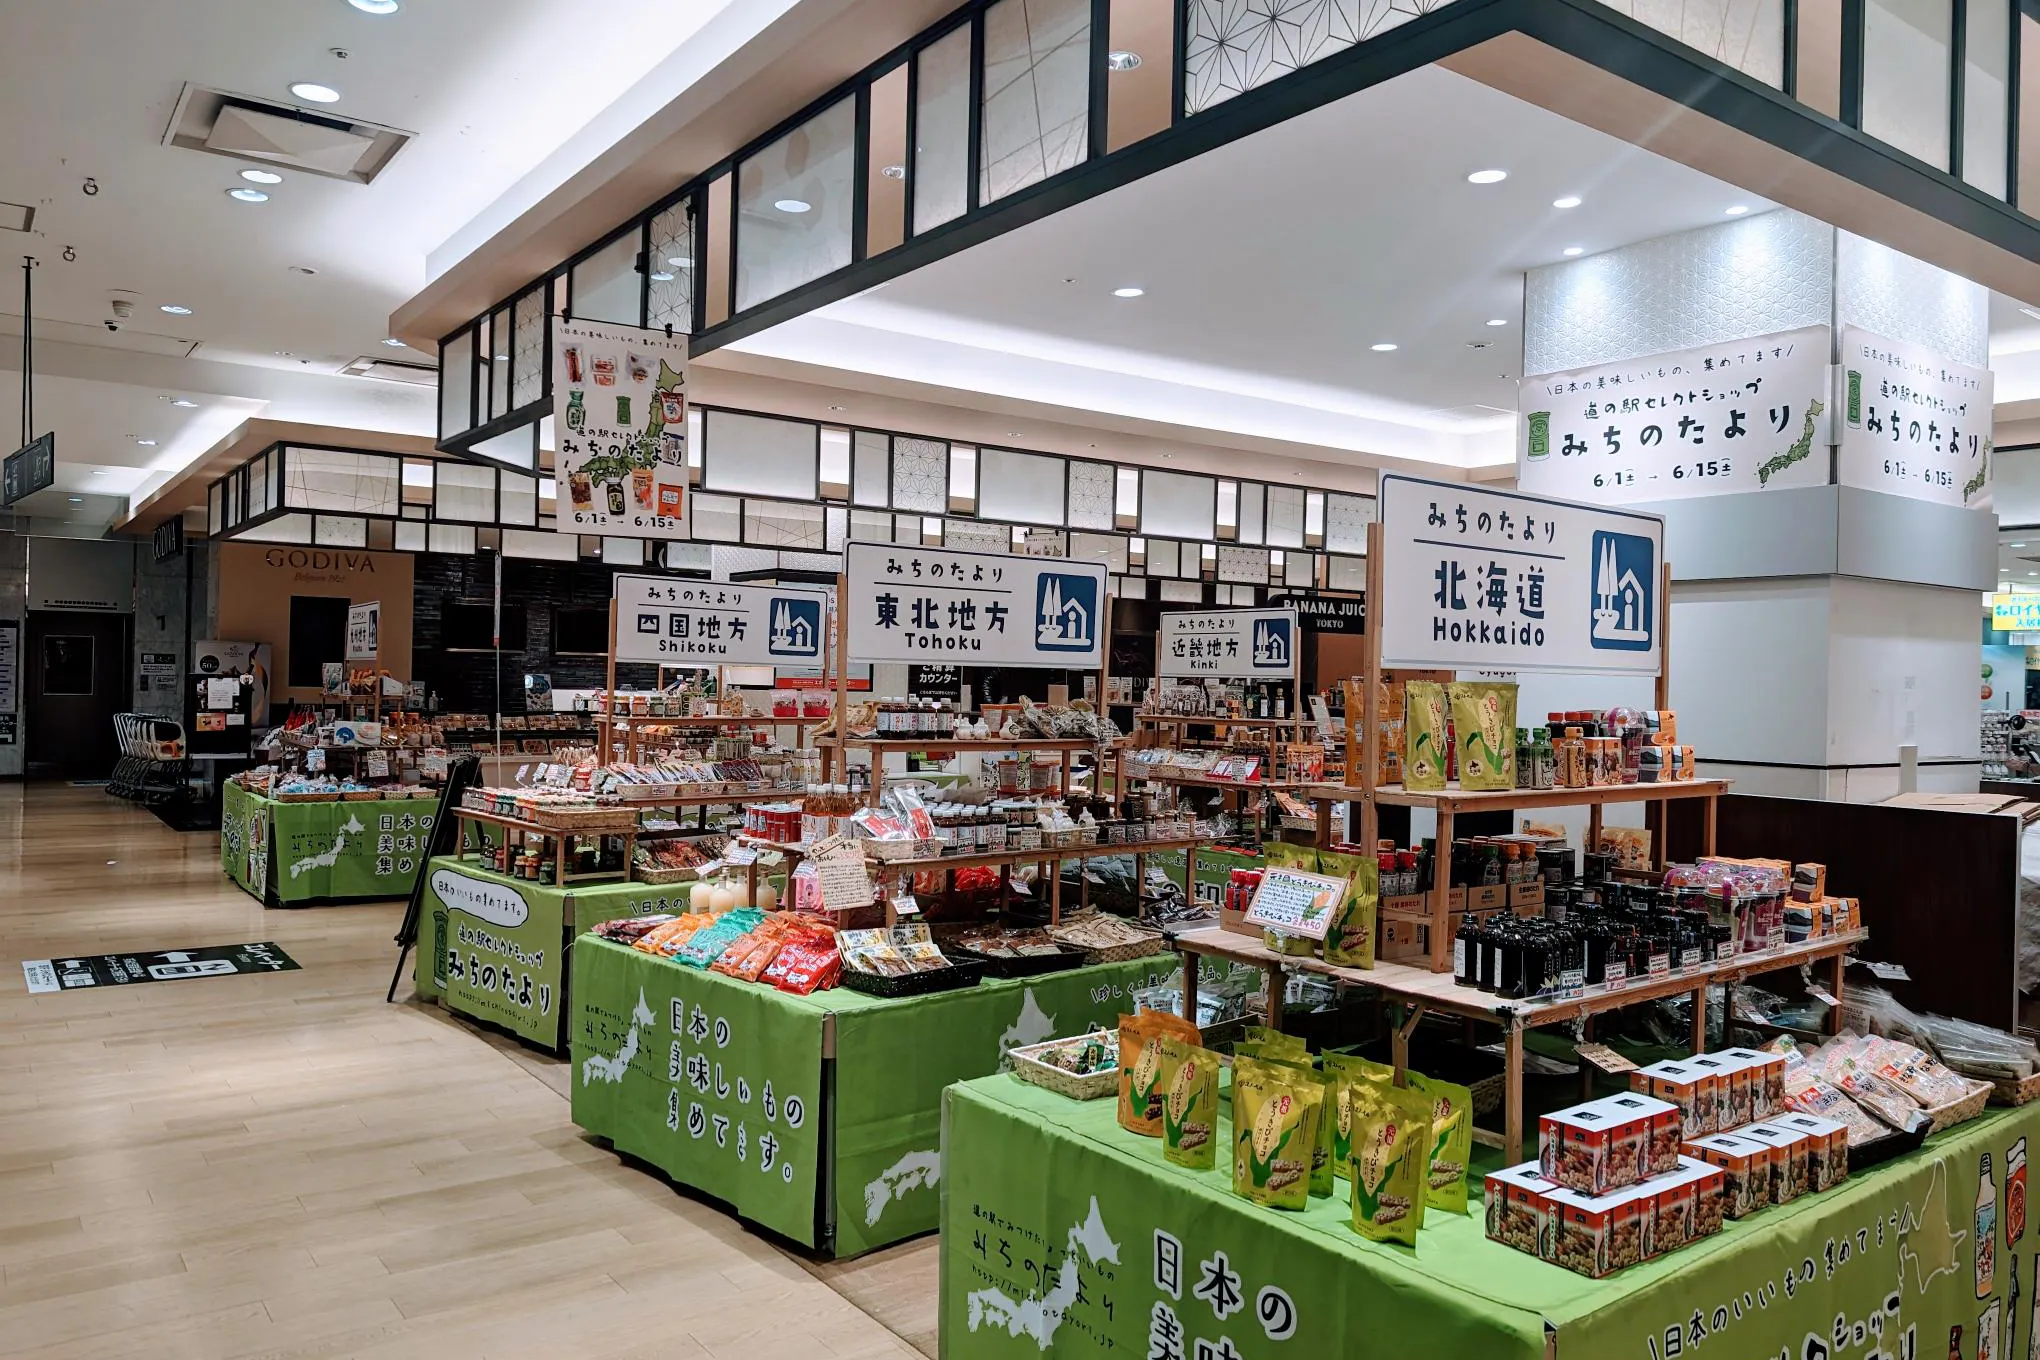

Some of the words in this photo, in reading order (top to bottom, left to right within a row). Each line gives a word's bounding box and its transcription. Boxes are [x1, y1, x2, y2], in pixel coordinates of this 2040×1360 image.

[1584, 378, 1762, 420] 道の駅セレクトショップ
[1880, 377, 1967, 417] 道の駅セレクトショップ
[1562, 405, 1790, 456] みちのたより
[1867, 406, 1978, 459] みちのたより
[563, 440, 682, 466] みちのたより
[1427, 503, 1555, 544] みちのたより
[265, 549, 375, 573] GODIVA
[887, 558, 1003, 583] みちのたより
[648, 587, 742, 605] みちのたより
[1434, 560, 1545, 620] 北海道
[875, 593, 1009, 634] 東北地方
[1283, 599, 1336, 615] BANANA
[1339, 604, 1365, 617] JUIC
[157, 615, 166, 631] 1
[637, 612, 747, 642] 四国地方
[1178, 618, 1235, 630] みちのたより
[1316, 618, 1344, 629] TOKYO
[1433, 616, 1545, 647] Hokkaido
[659, 639, 727, 654] Shikoku
[905, 632, 981, 651] Tohoku
[1172, 637, 1239, 659] 近畿地方
[1190, 657, 1218, 670] Kinki
[919, 672, 958, 684] カウンター
[381, 814, 433, 831] 日本の
[378, 858, 412, 873] 集め
[458, 921, 544, 968] 道の駅セレクトショップ
[449, 951, 550, 1014] みちのたより
[672, 1001, 729, 1046] 日本の
[671, 1046, 802, 1125] 美味しいもの
[1260, 1099, 1277, 1157] とうきびチョコ
[1156, 1235, 1293, 1333] 日本の
